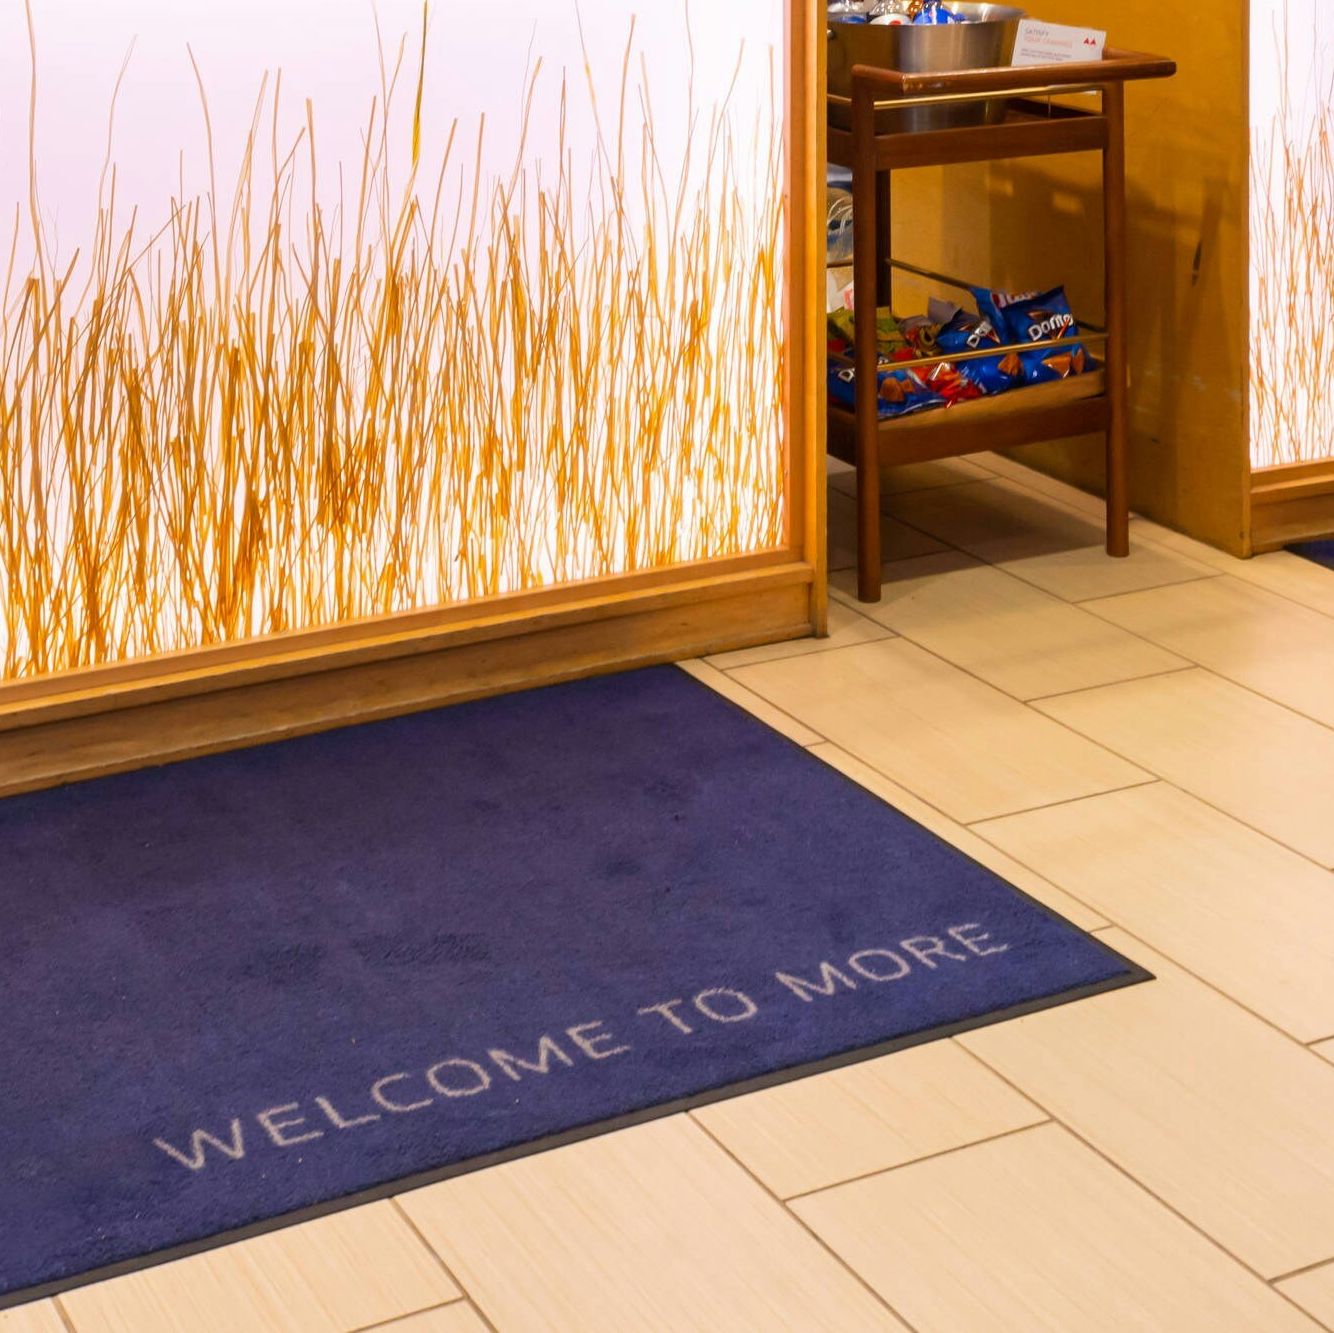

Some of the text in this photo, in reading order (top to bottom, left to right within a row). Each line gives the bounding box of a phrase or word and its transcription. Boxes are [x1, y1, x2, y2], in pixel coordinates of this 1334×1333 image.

[153, 921, 1009, 1172] WELCOME TO MORE
